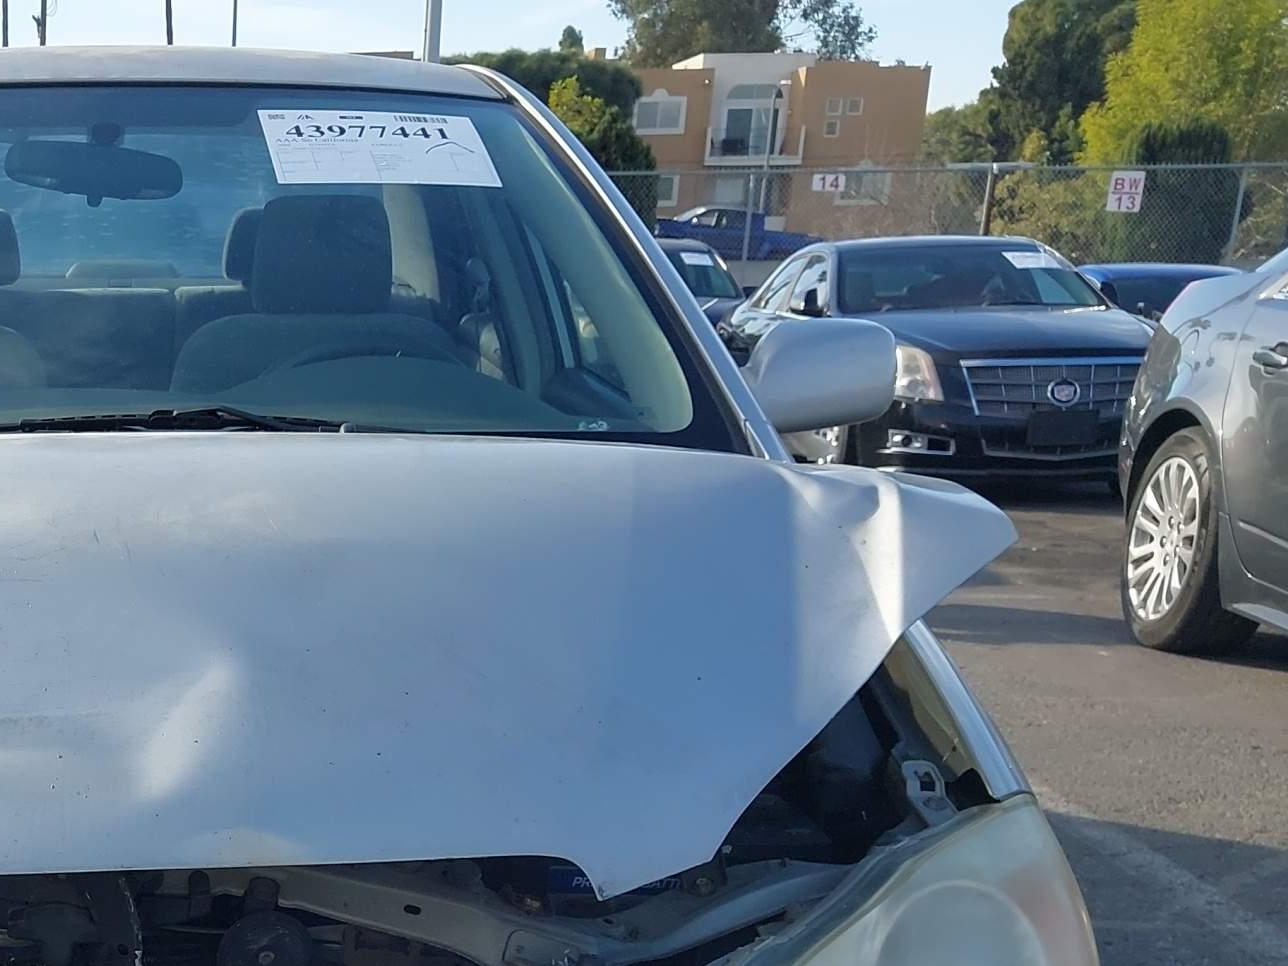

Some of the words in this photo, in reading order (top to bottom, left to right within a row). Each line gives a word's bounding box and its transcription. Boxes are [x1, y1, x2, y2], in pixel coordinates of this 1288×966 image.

[285, 124, 449, 140] 43977441
[819, 175, 840, 190] 14
[1114, 177, 1142, 191] BW
[1114, 195, 1136, 210] 13
